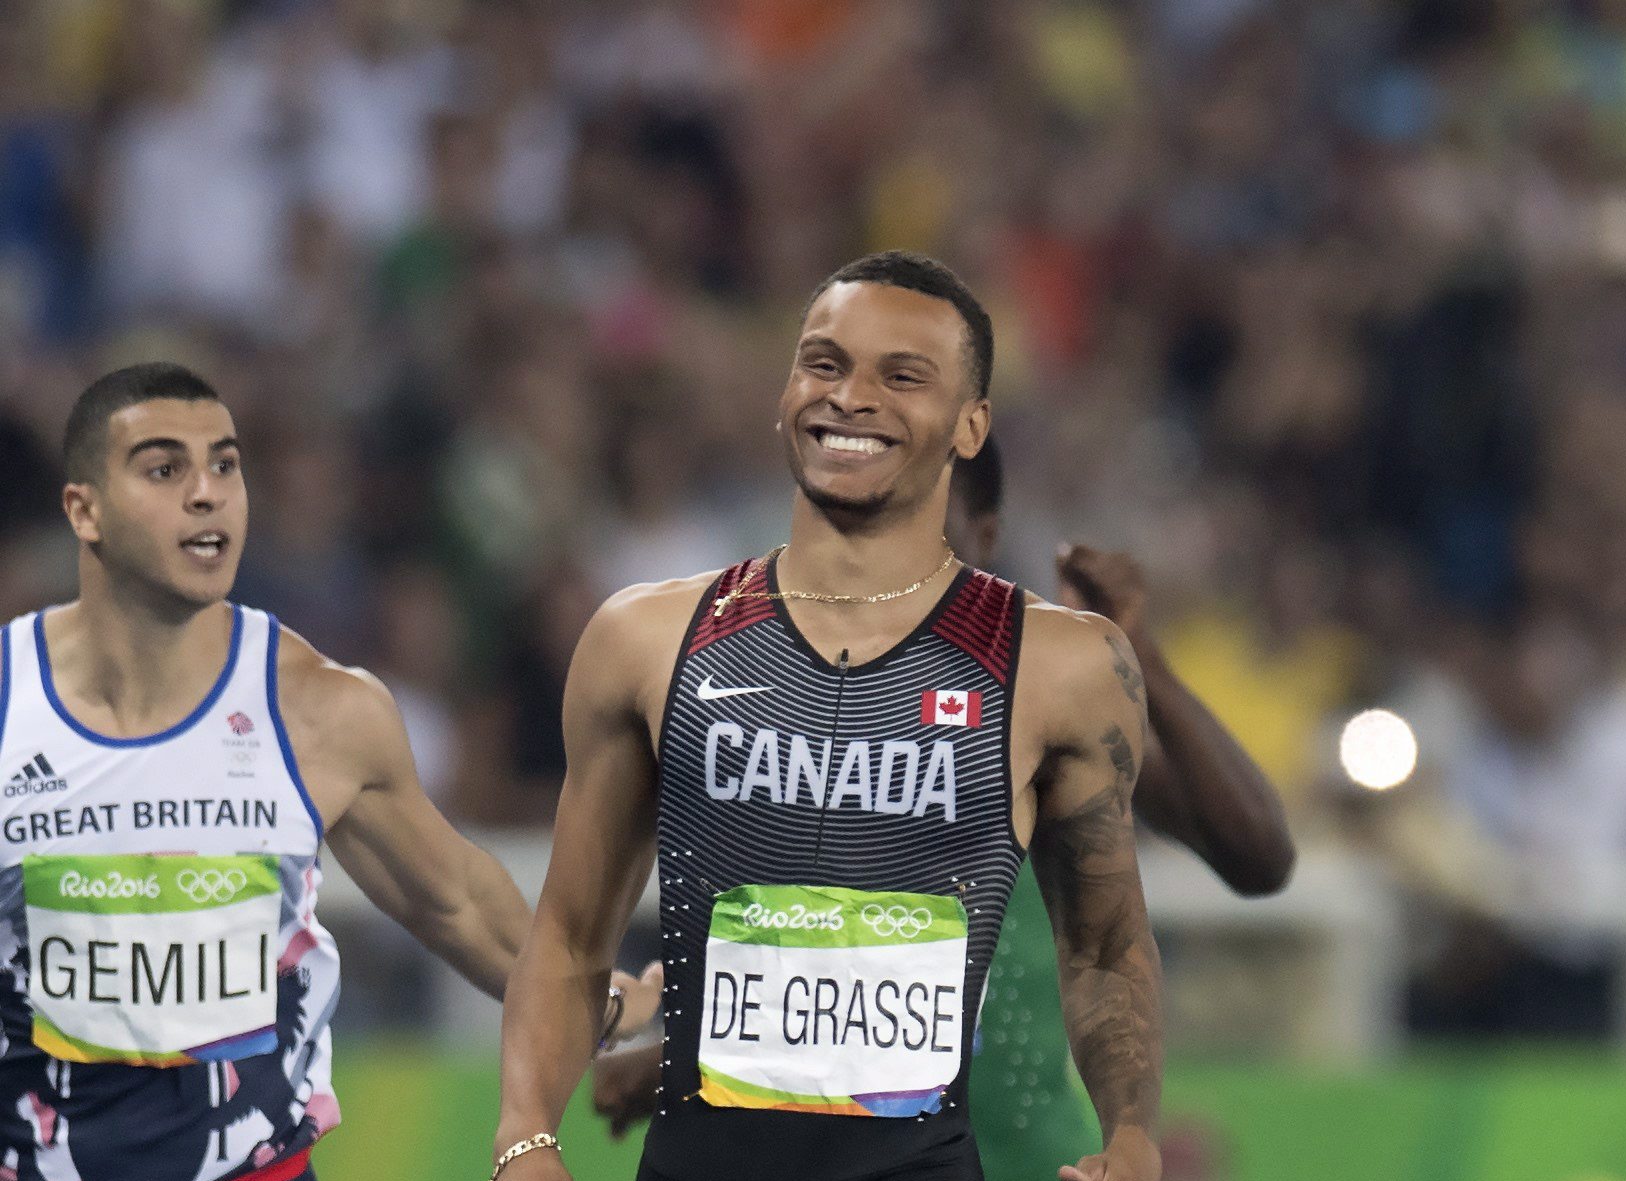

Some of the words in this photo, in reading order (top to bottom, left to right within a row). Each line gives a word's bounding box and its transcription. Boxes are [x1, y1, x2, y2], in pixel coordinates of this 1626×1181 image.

[5, 778, 68, 798] adidas
[705, 721, 957, 822] CANADA
[3, 803, 121, 844] GREAT
[133, 799, 278, 830] BRITAIN
[59, 871, 162, 899] Rio2016
[743, 903, 845, 931] Rio2016
[39, 933, 269, 1006] GEMILI
[710, 971, 764, 1042] DE
[782, 976, 957, 1054] GRASSE
